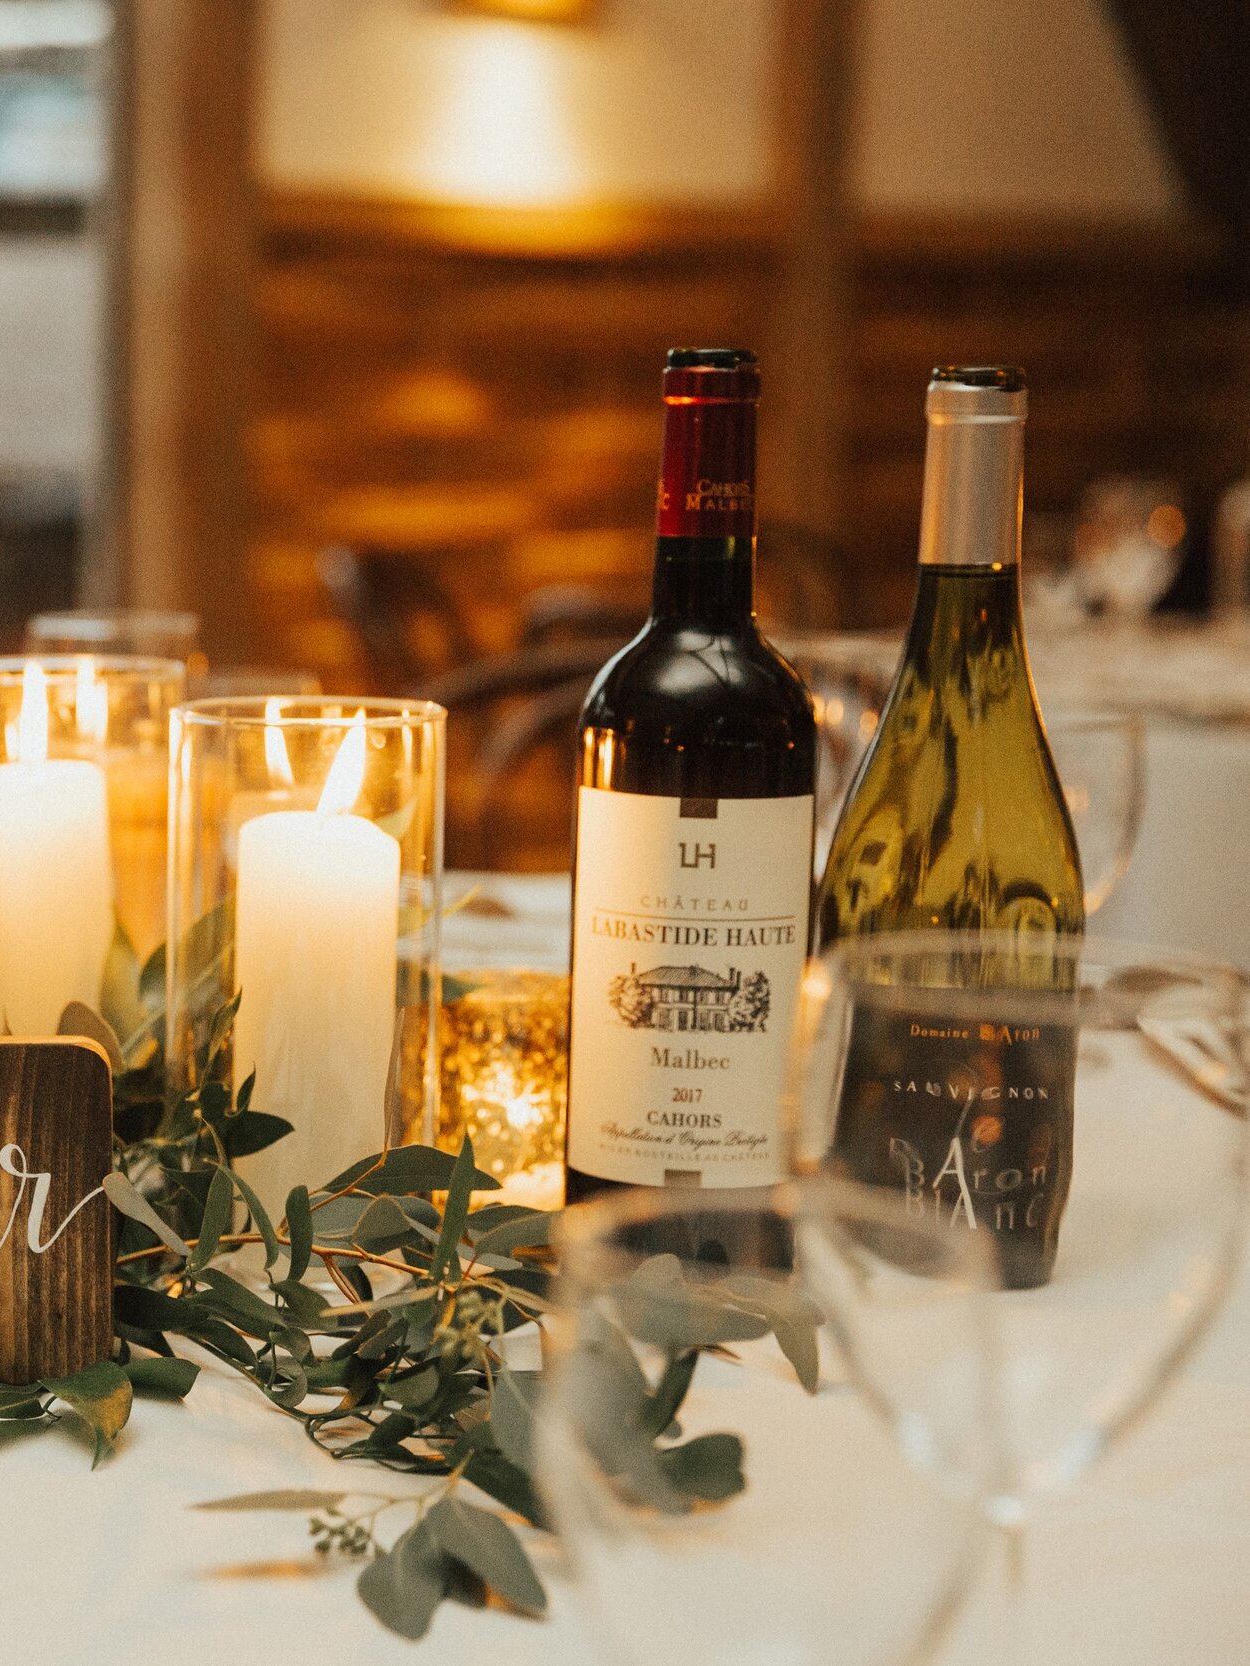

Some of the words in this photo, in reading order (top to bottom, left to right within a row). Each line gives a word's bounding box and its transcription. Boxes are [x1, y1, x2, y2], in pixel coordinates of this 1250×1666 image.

[591, 916, 718, 947] LABASTIDE
[725, 925, 796, 947] HAUTE
[910, 1024, 970, 1039] Domaine
[651, 1047, 731, 1070] Malbec
[672, 1087, 703, 1103] 2017
[893, 1080, 1049, 1101] SAUVIGNON
[647, 1110, 723, 1129] CAHORS
